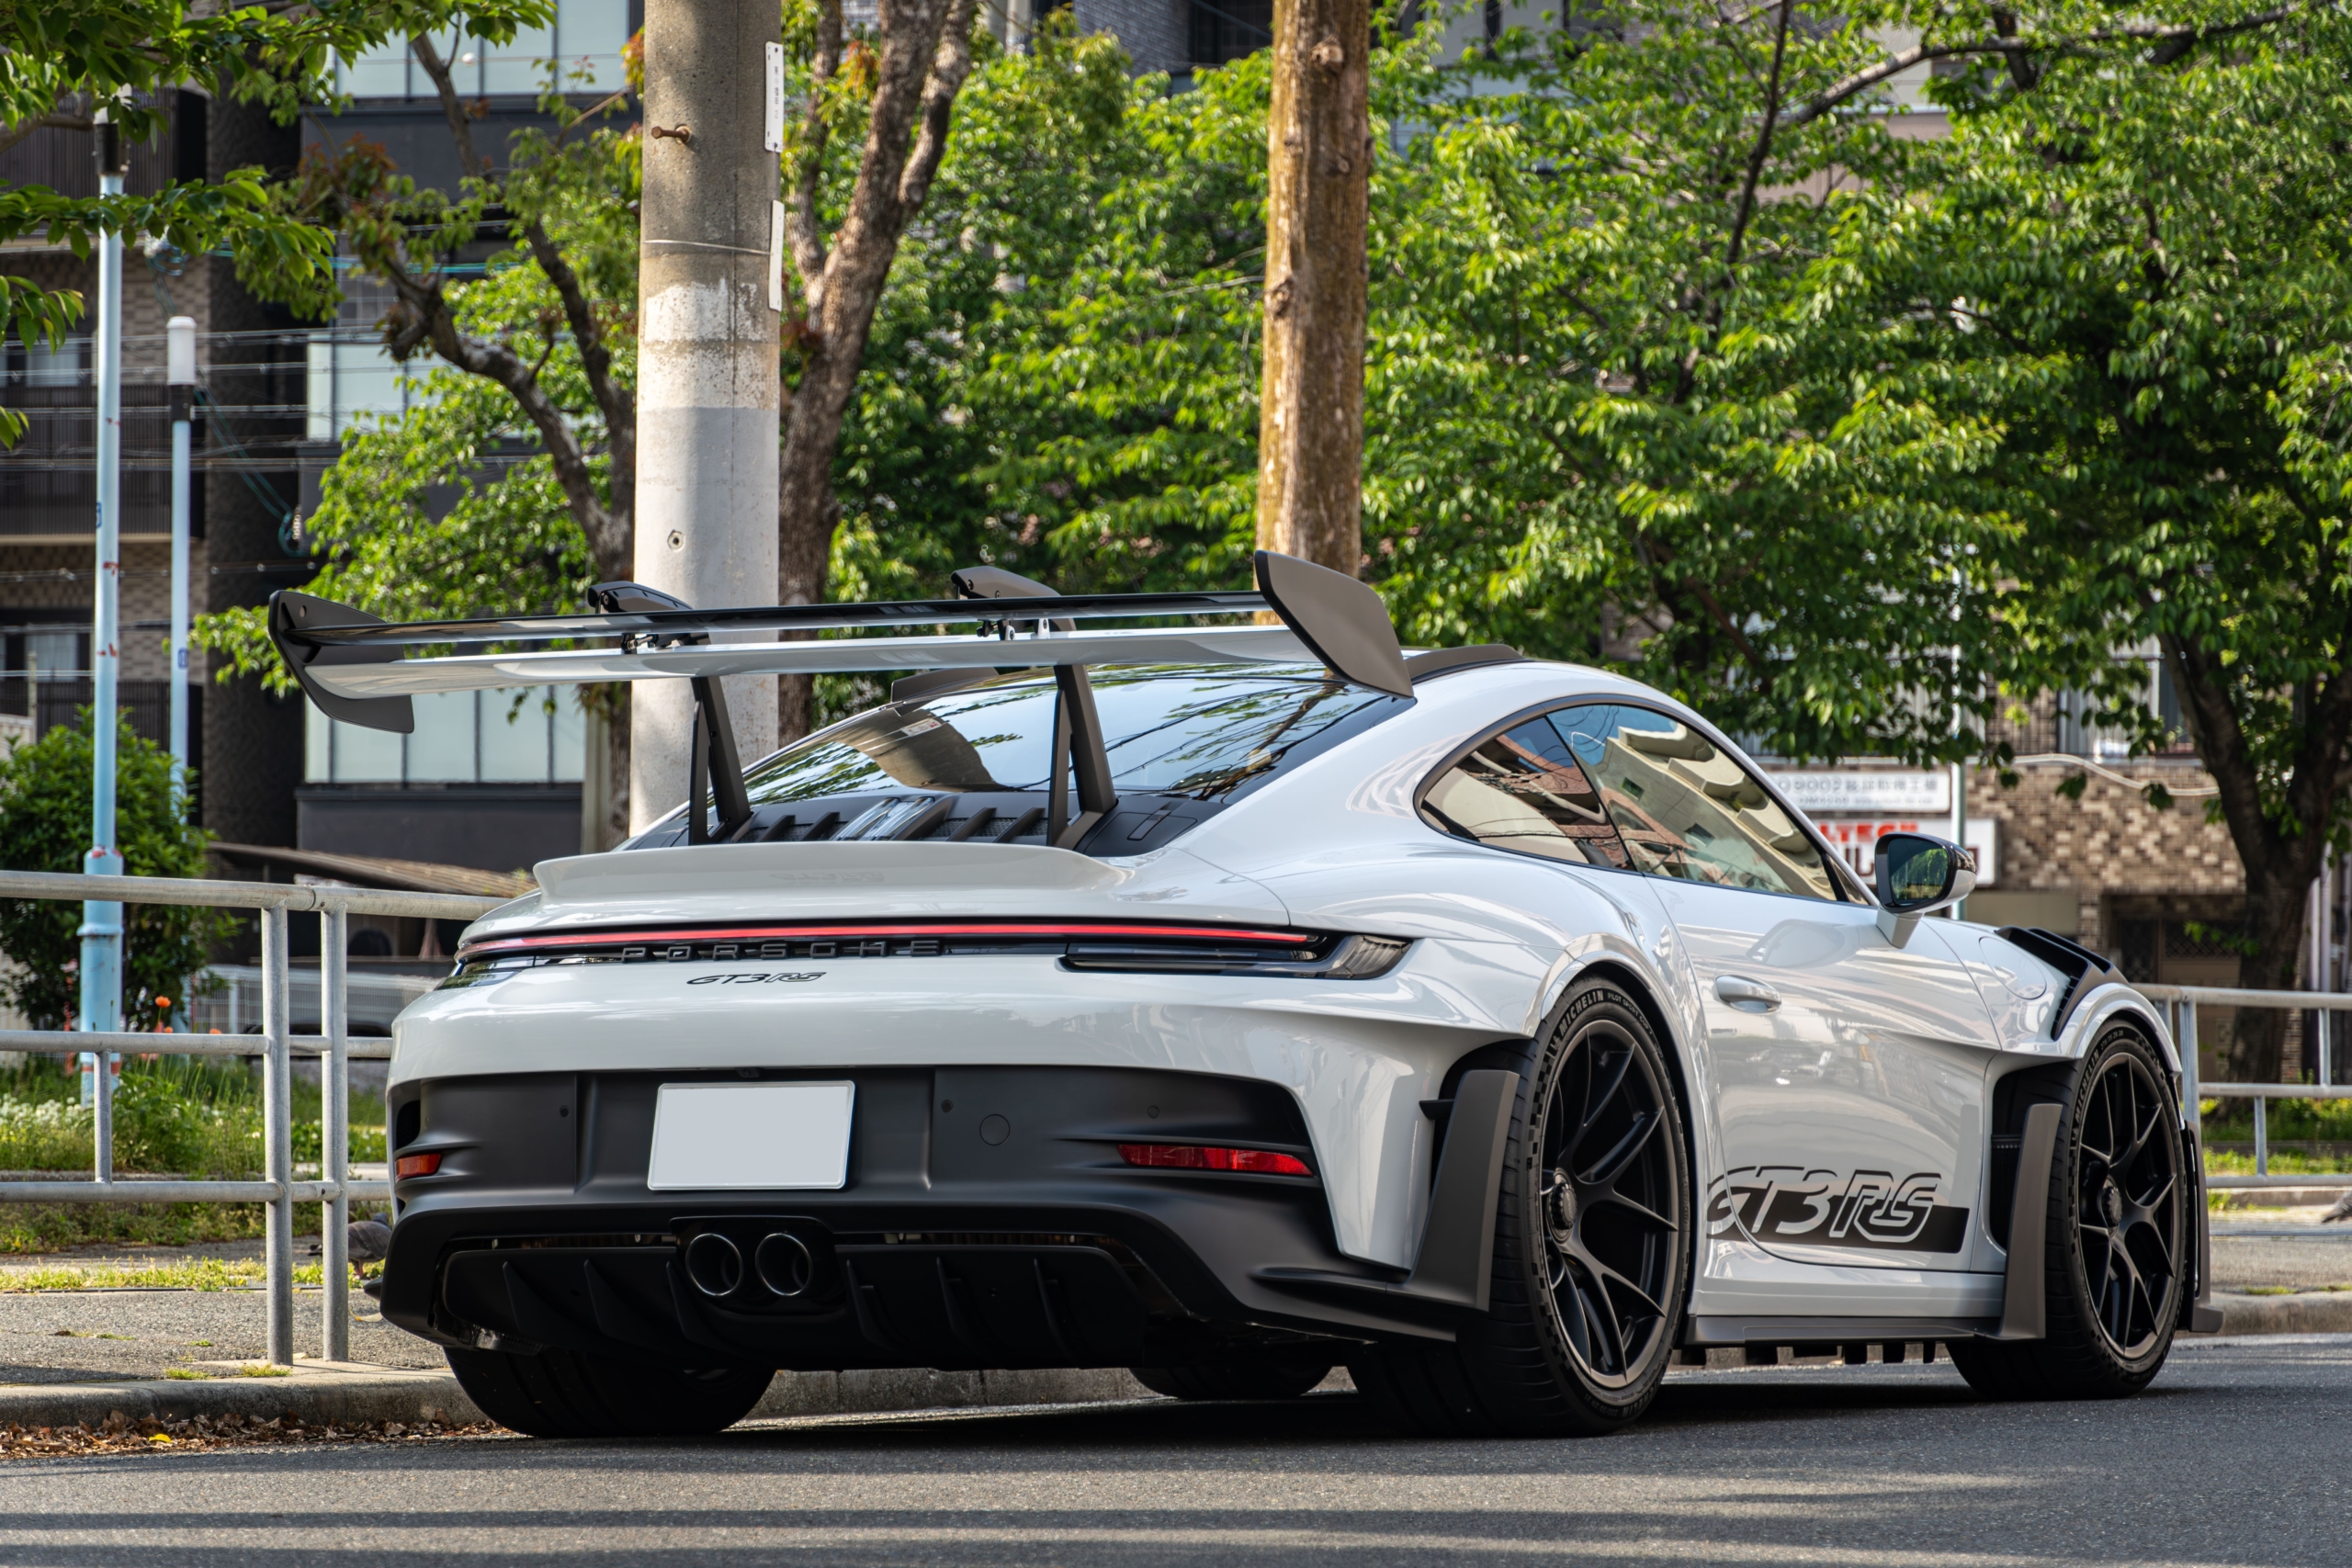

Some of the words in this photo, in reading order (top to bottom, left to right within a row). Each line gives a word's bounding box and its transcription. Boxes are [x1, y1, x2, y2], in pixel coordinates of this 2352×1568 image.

[621, 940, 941, 964] PORSCHE
[1559, 989, 1604, 1036] MICHELIN
[1608, 992, 1622, 1003] PILOT
[1623, 998, 1639, 1019] SPORT
[2075, 1050, 2099, 1123] MICHELIN
